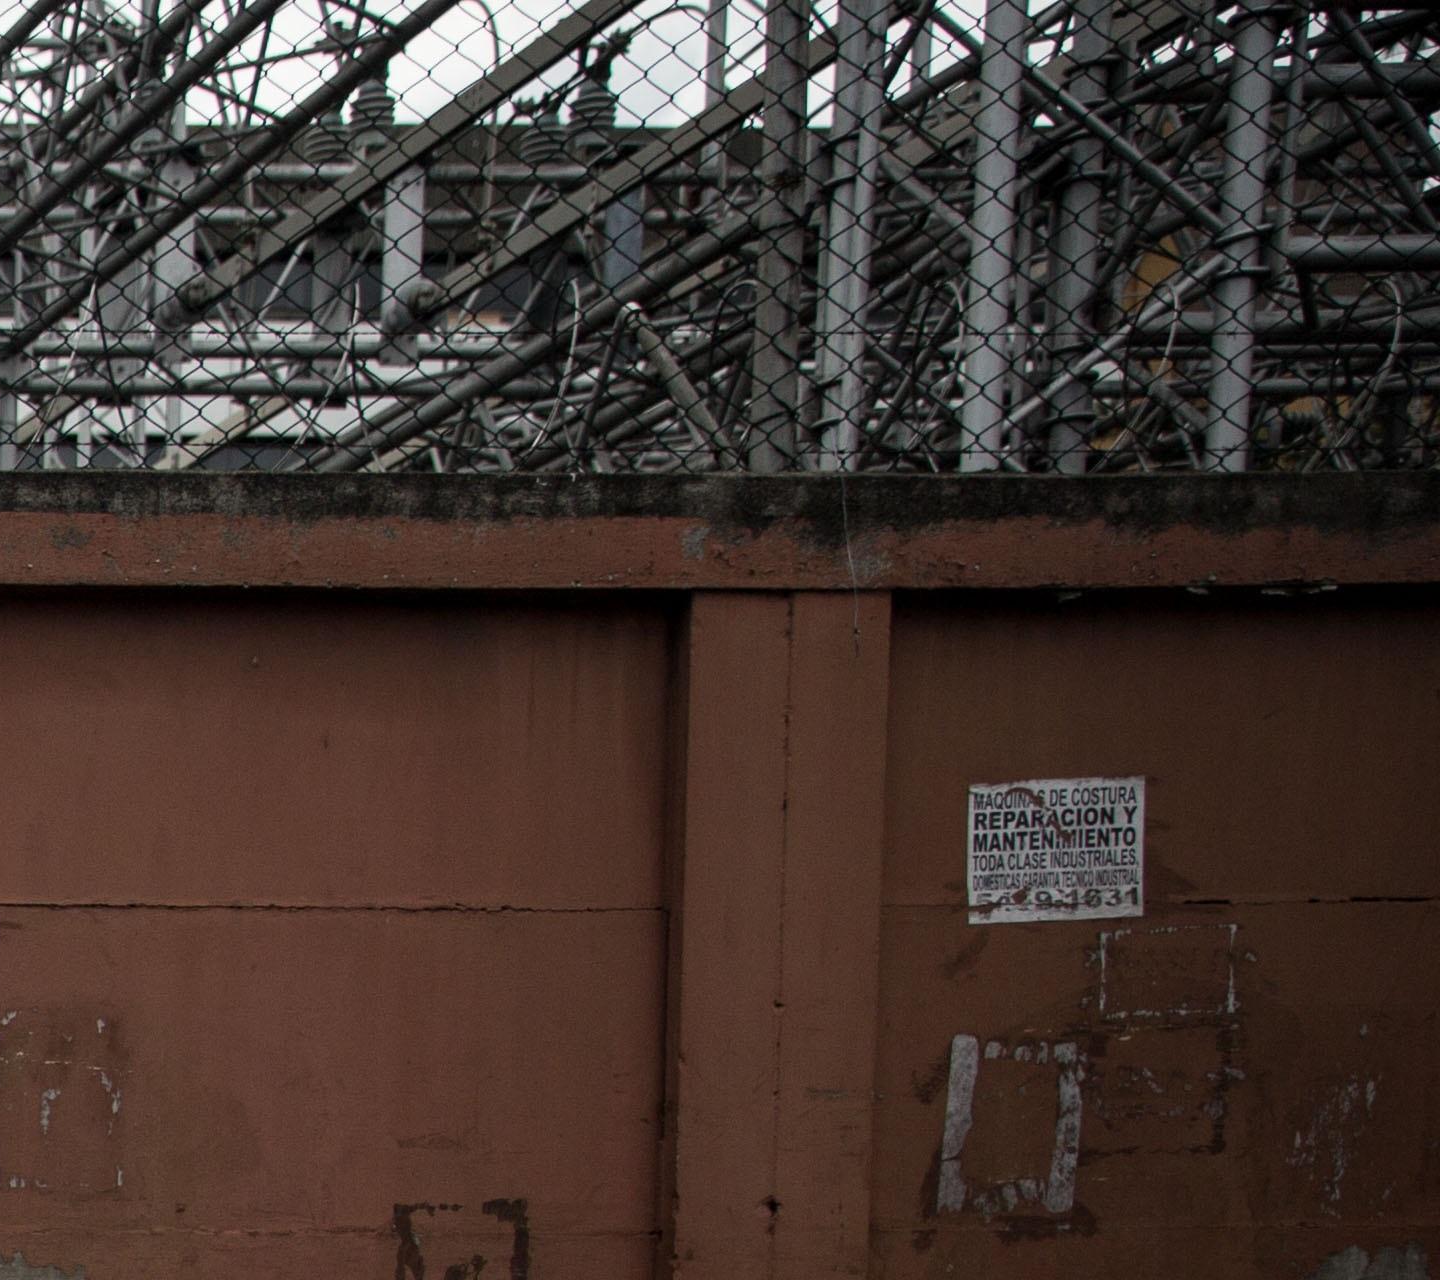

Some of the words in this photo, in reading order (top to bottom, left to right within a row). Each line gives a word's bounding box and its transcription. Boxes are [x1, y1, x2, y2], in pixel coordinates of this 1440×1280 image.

[1049, 789, 1068, 807] DE
[1071, 786, 1137, 805] COSTURA
[974, 807, 1114, 830] REPARACION
[1123, 806, 1137, 824] Y
[973, 855, 1005, 872] TODA
[1007, 852, 1047, 870] CLASE
[1095, 868, 1139, 887] INDUSTRIAL
